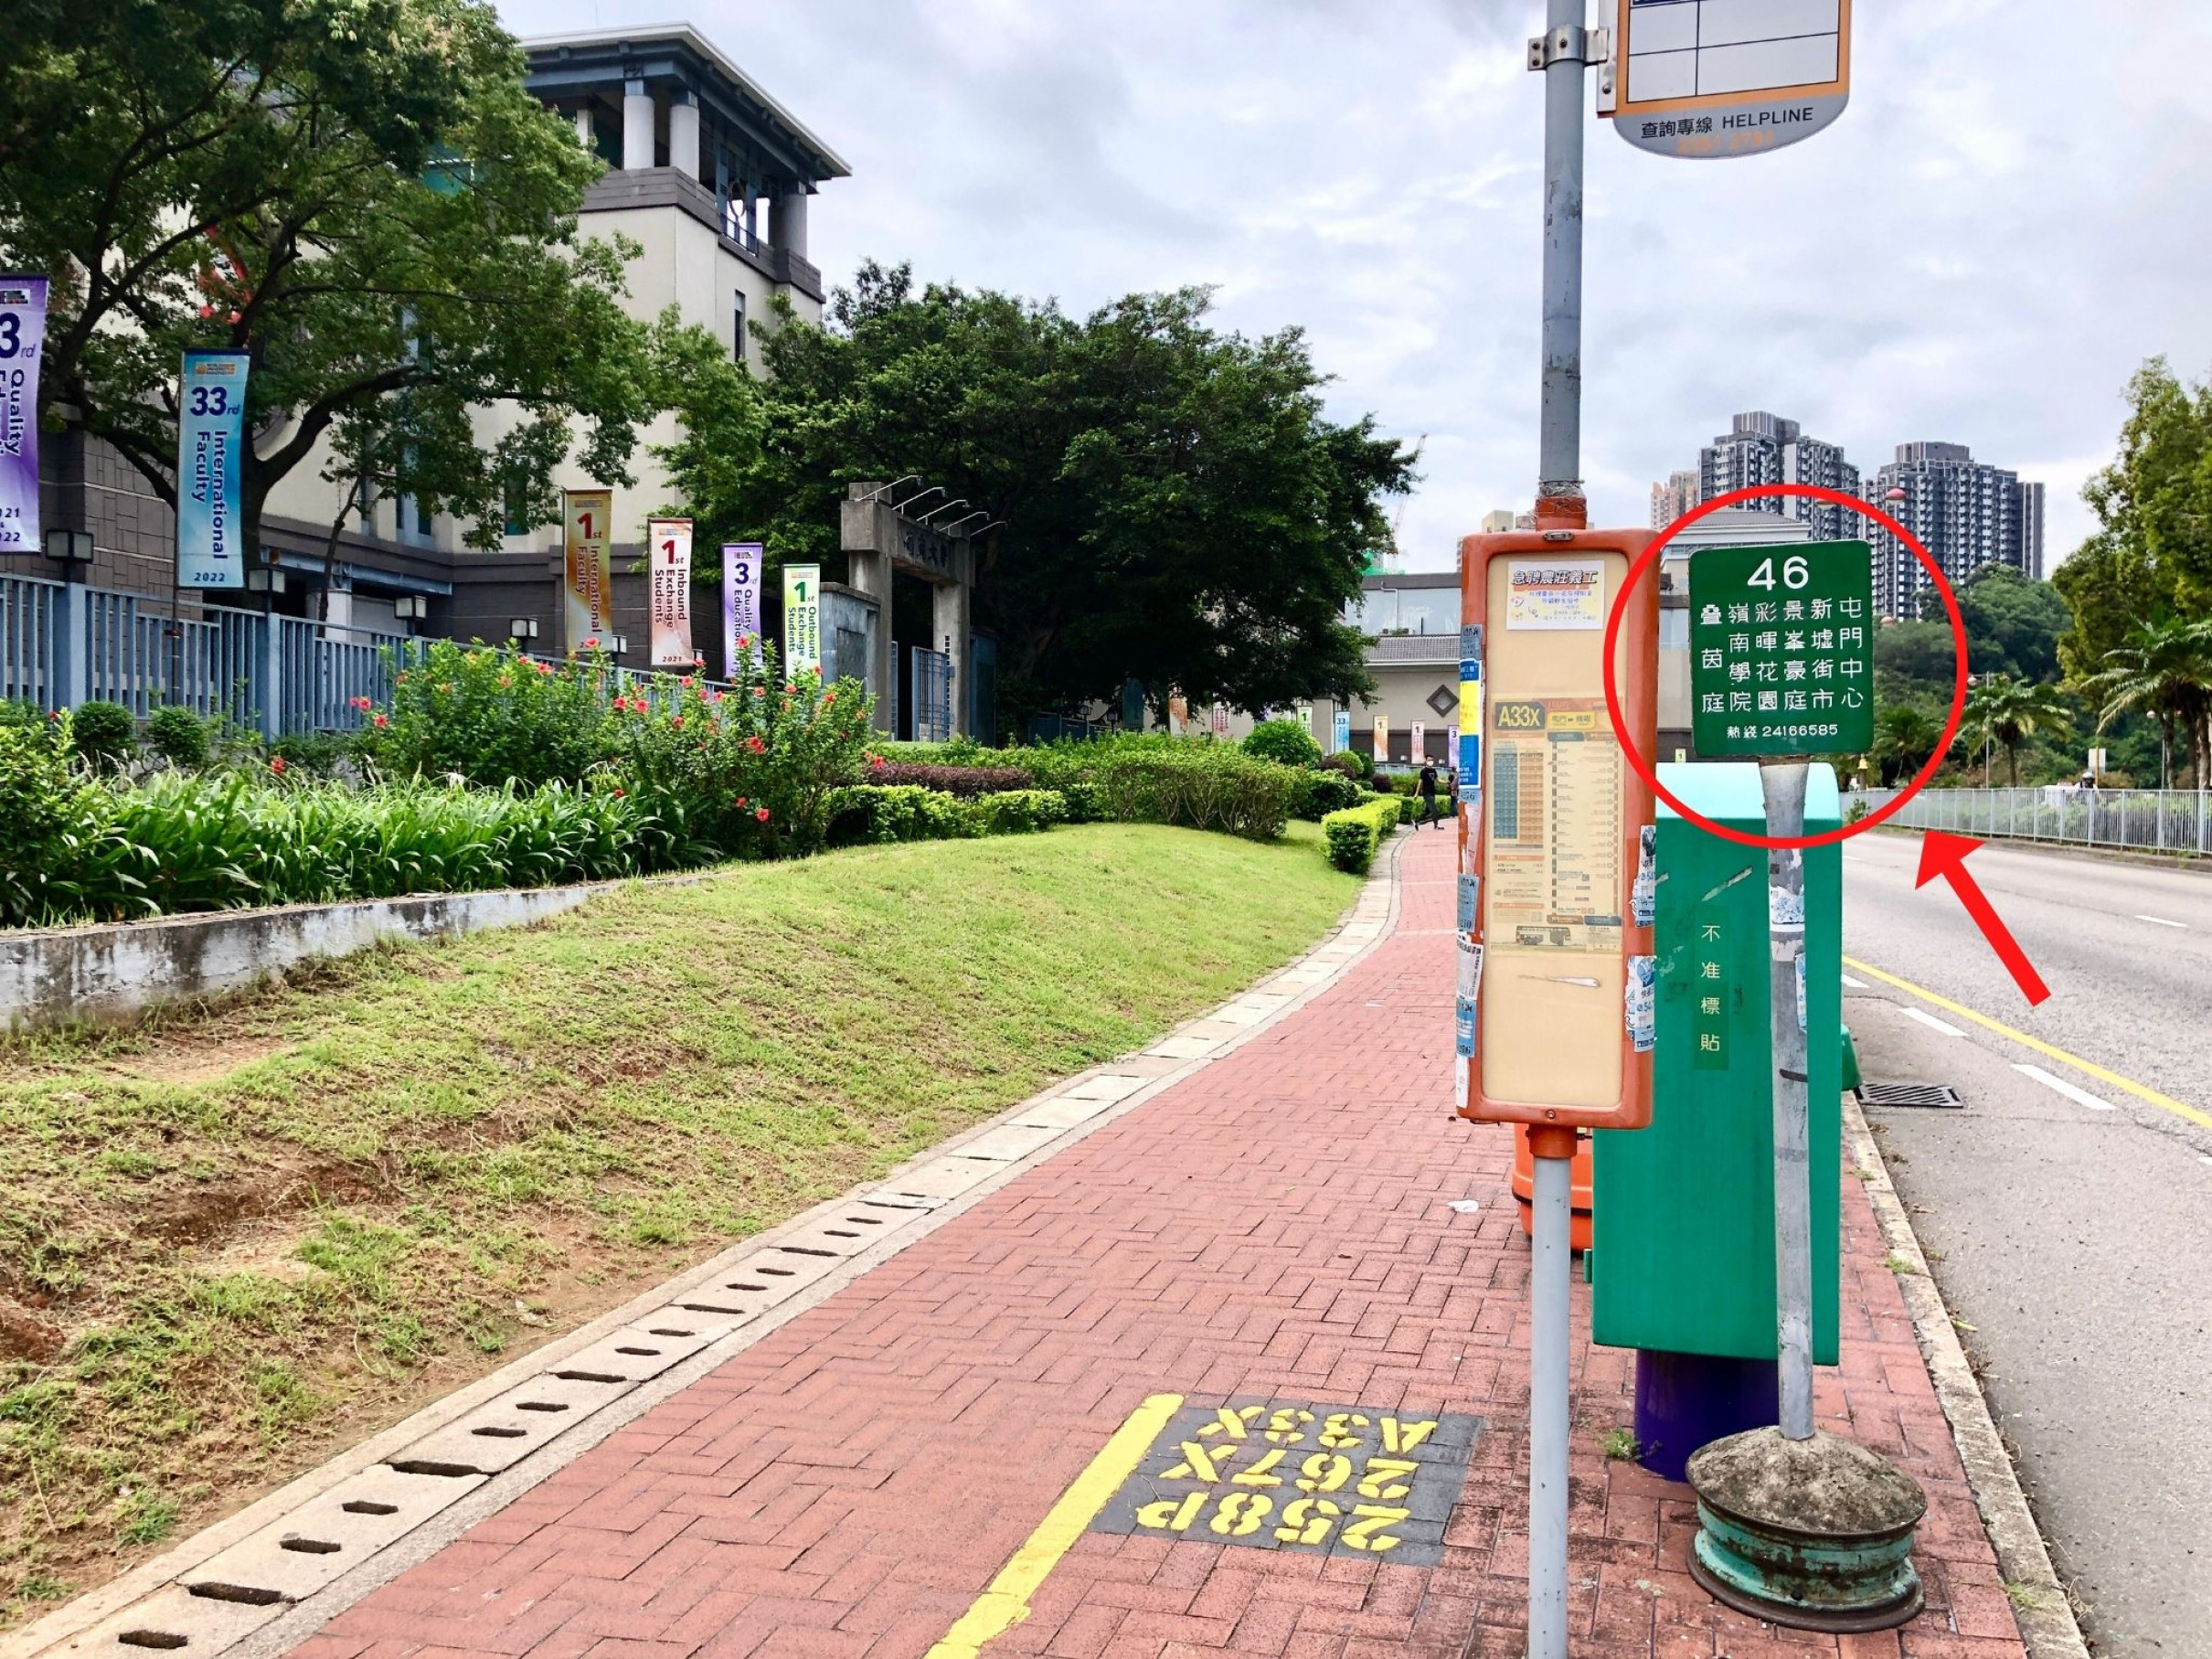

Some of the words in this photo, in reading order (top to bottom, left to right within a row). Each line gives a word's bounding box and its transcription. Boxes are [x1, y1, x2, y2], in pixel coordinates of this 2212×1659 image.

[1641, 116, 1714, 139] 查詢專線
[1722, 107, 1813, 130] HELPLINE
[5, 368, 25, 455] Quality
[189, 386, 241, 417] 33rd
[191, 431, 210, 503] Faculty
[212, 431, 229, 559] International
[577, 512, 602, 540] 1st
[194, 572, 226, 582] 2022
[575, 546, 588, 595] Faculty
[661, 539, 685, 565] 1st
[1747, 555, 1809, 591] 46
[590, 546, 603, 633] International
[654, 569, 665, 623] Students
[666, 569, 676, 629] Exchange
[677, 569, 688, 621] Inbound
[742, 589, 752, 630] Quality
[788, 606, 796, 653] Students
[797, 606, 807, 656] Exchange
[808, 606, 817, 660] Outbound
[1761, 724, 1838, 738] 24166585
[1700, 924, 1721, 1052] 不准標貼
[1196, 1405, 1439, 1453] A33X
[1158, 1441, 1420, 1499] 267X
[1135, 1491, 1411, 1552] 258P
